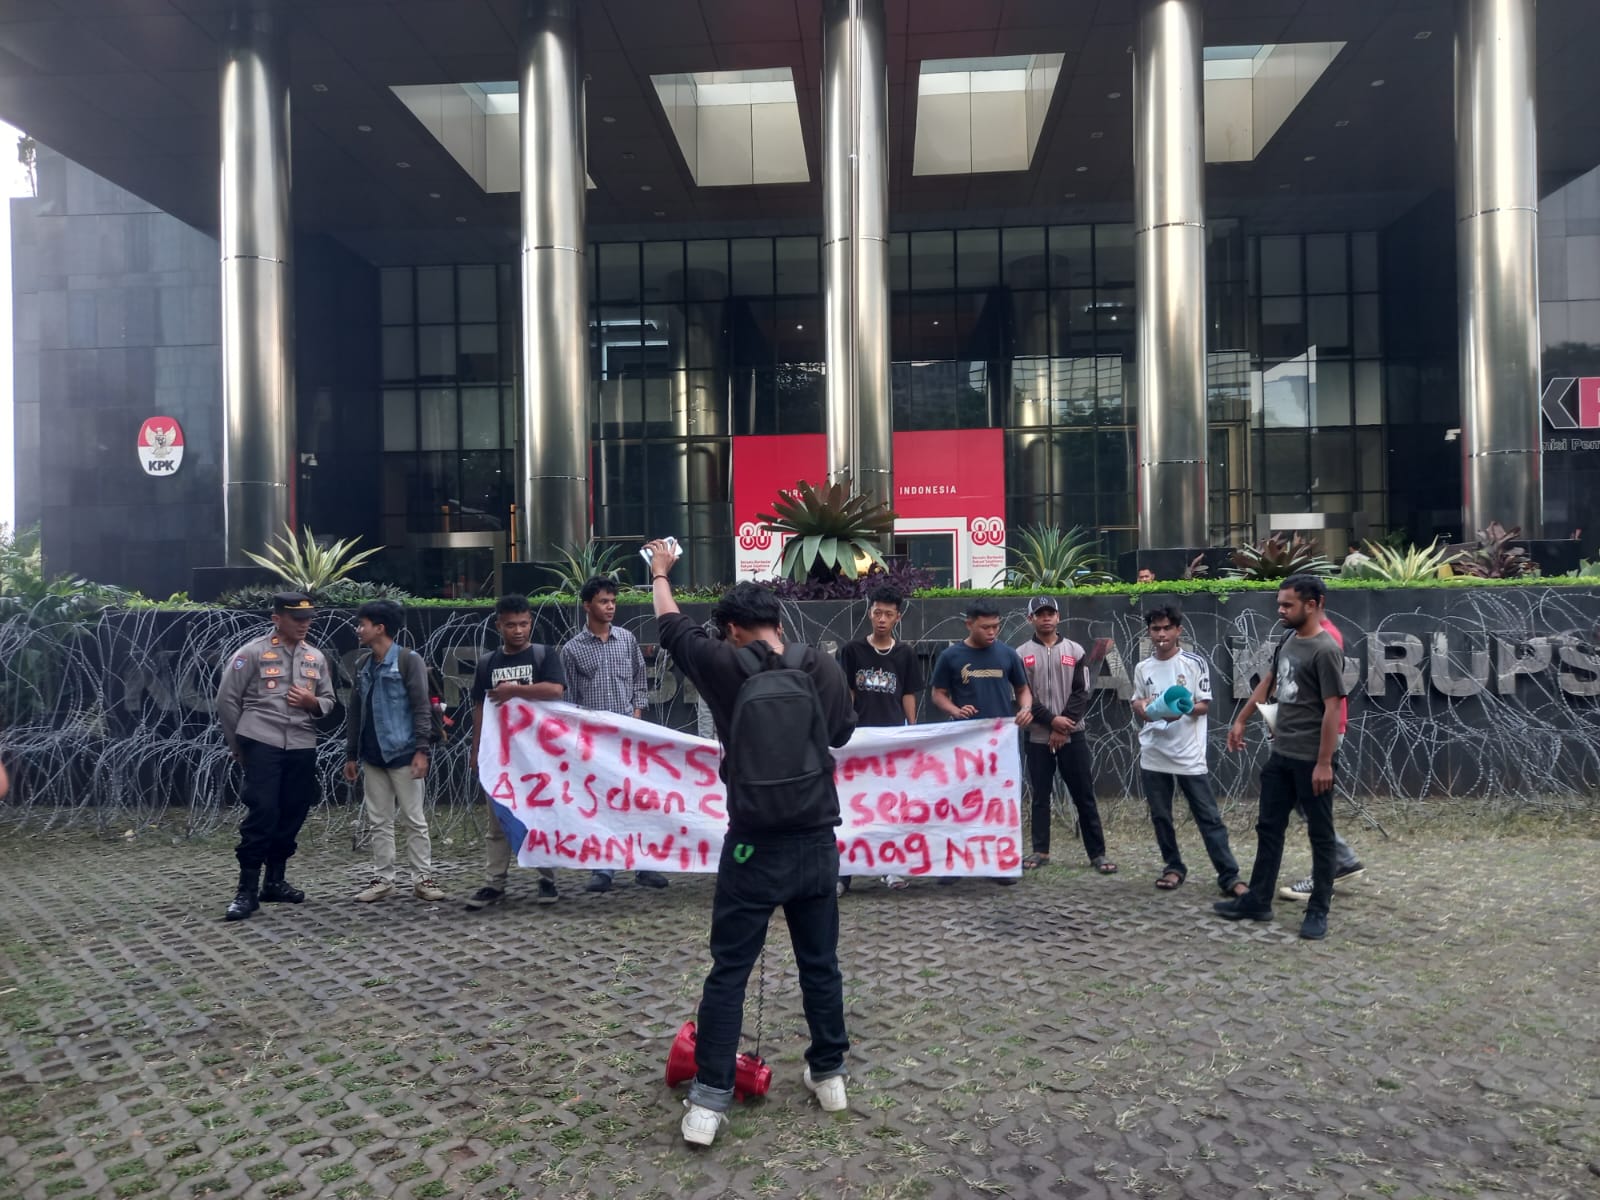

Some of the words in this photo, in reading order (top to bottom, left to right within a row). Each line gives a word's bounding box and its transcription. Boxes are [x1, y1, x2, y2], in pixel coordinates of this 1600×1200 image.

[148, 459, 175, 472] KPK
[899, 484, 957, 496] INDONESIA
[739, 521, 772, 551] 80
[970, 516, 1005, 546] 80
[493, 665, 532, 679] WANTED
[944, 834, 1020, 872] NTB
